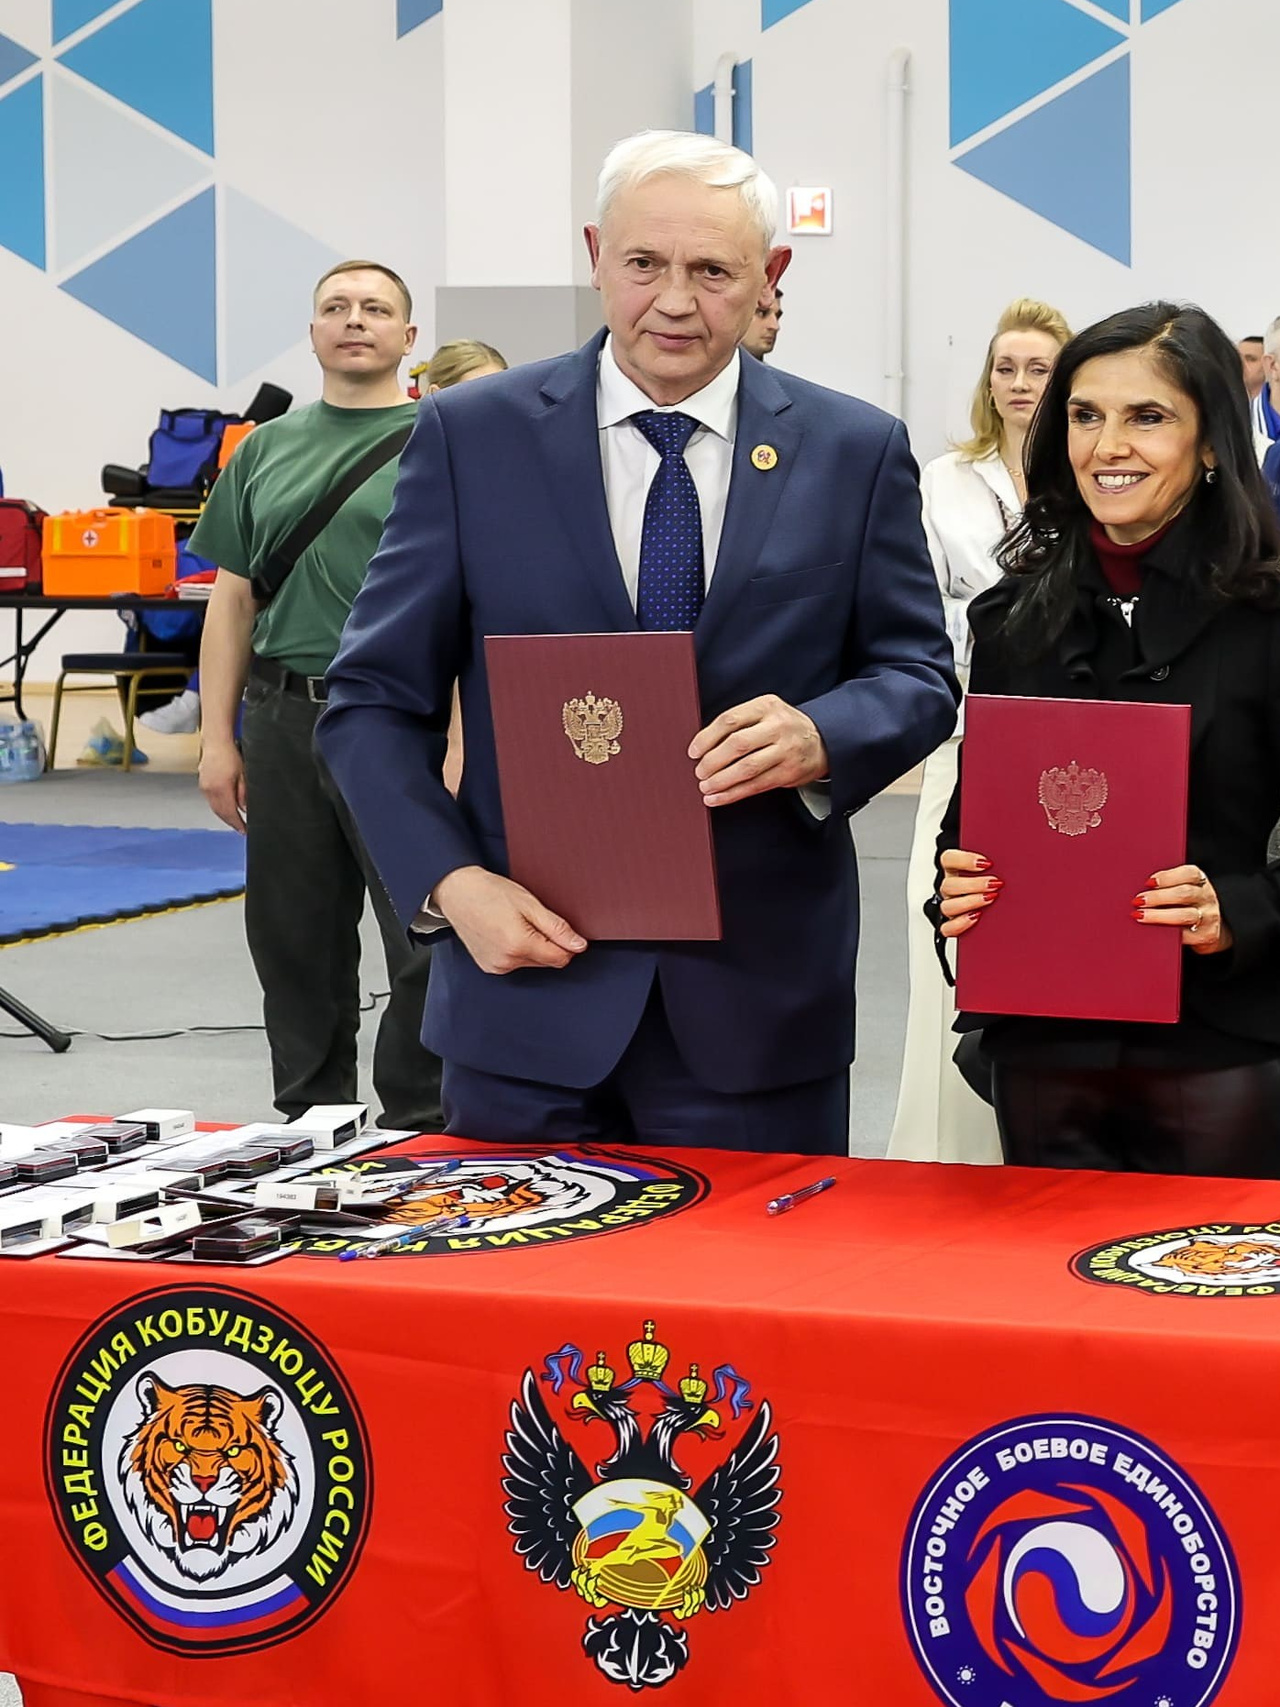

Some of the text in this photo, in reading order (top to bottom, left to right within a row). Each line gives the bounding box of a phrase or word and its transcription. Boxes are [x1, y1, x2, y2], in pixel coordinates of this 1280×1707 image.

[447, 1183, 685, 1250] ФЕДЕРАЦИЯ
[1089, 1225, 1232, 1269] КОБУДЗЮЦУ
[1092, 1267, 1276, 1296] ФЕДЕРАЦИЯ
[62, 1307, 355, 1587] ФЕДЕРАЦИЯ КОБУДЗЮЦУ РОССИИ
[922, 1437, 1218, 1670] ВОСТОЧНОЕ БОЕВОЕ ЕДИНОБОРСТВО
